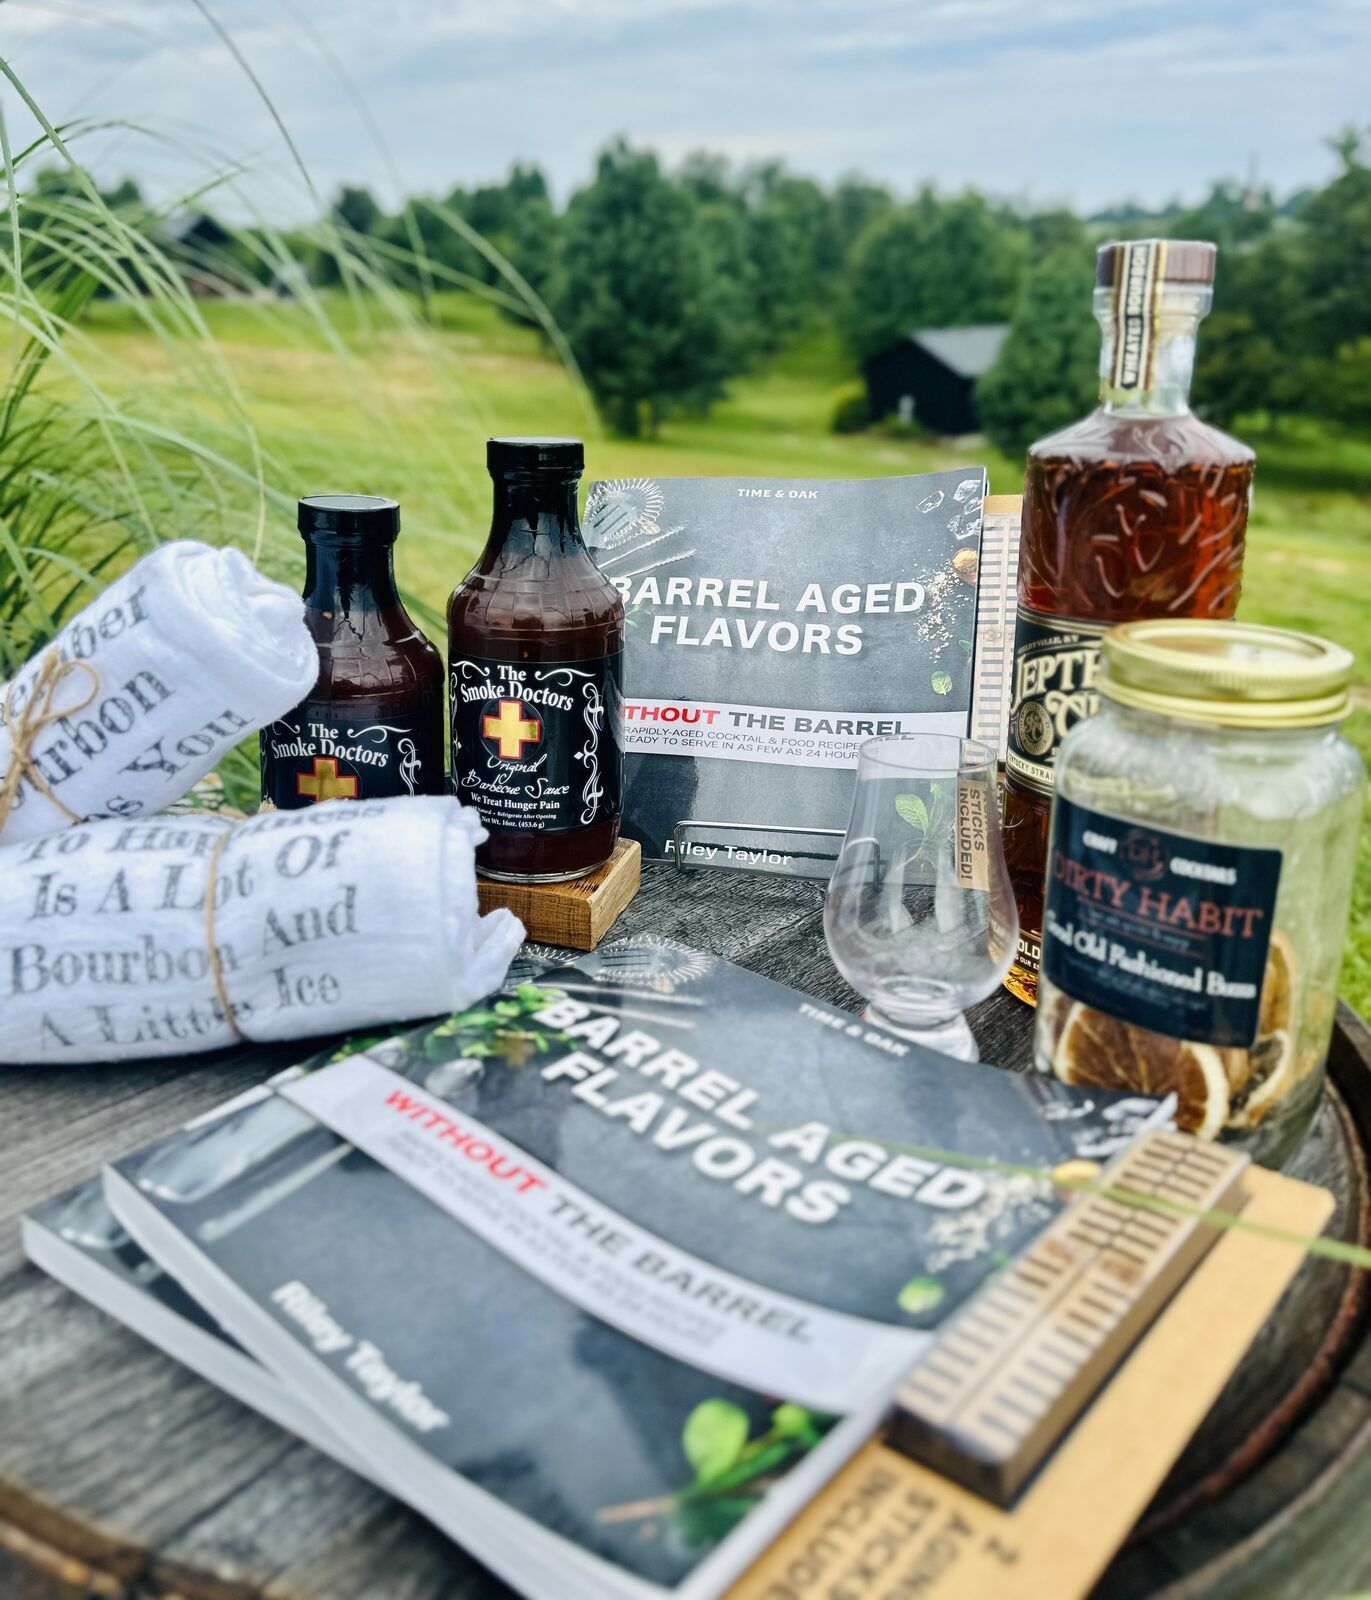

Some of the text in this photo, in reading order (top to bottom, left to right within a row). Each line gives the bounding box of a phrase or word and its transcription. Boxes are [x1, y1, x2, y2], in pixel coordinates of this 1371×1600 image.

[737, 488, 819, 499] TIME & OAK
[609, 576, 926, 615] BARREL AGED
[650, 615, 864, 656] FLAVORS
[497, 665, 527, 681] The
[460, 679, 574, 711] Smoke Doctors
[308, 722, 339, 739] The
[624, 705, 911, 736] THOUT THE BARREL
[117, 710, 254, 783] You
[270, 737, 389, 767] Smoke Doctors
[624, 735, 860, 760] READY TO SERVE IN AS FEW AS 24 HOUR
[625, 727, 862, 750] RAPIDLY-AGED COCKTAIL & FOOD RECIPE
[461, 769, 570, 799] Barbecue Sauce
[487, 753, 548, 784] Original
[470, 791, 560, 811] We Treat Hunger Pain
[497, 811, 523, 819] Refrigerate
[481, 816, 491, 824] Net
[491, 817, 502, 825] Wt.
[502, 819, 518, 828] 16oz.
[518, 821, 538, 829] (453.6
[959, 787, 974, 880] INCLUDED!
[969, 788, 985, 852] STICKS
[20, 832, 90, 863] To
[664, 839, 793, 866] Riley Taylor
[27, 872, 77, 920] Is
[95, 868, 134, 914] A
[274, 829, 352, 879] Of
[1052, 852, 1131, 907] DIRTY
[1137, 887, 1265, 938] HABIT
[8, 883, 360, 999] Bourbon And
[1074, 929, 1107, 962] Old
[41, 966, 342, 1051] A Little Ice
[799, 1002, 910, 1058] TIME & OAK
[533, 994, 988, 1210] BARREL AGED
[540, 1048, 852, 1225] FLAVORS
[383, 1089, 551, 1196] WITHOUT
[548, 1193, 633, 1257] THE
[632, 1246, 816, 1347] BARREL
[271, 1279, 450, 1433] Riley Taylor
